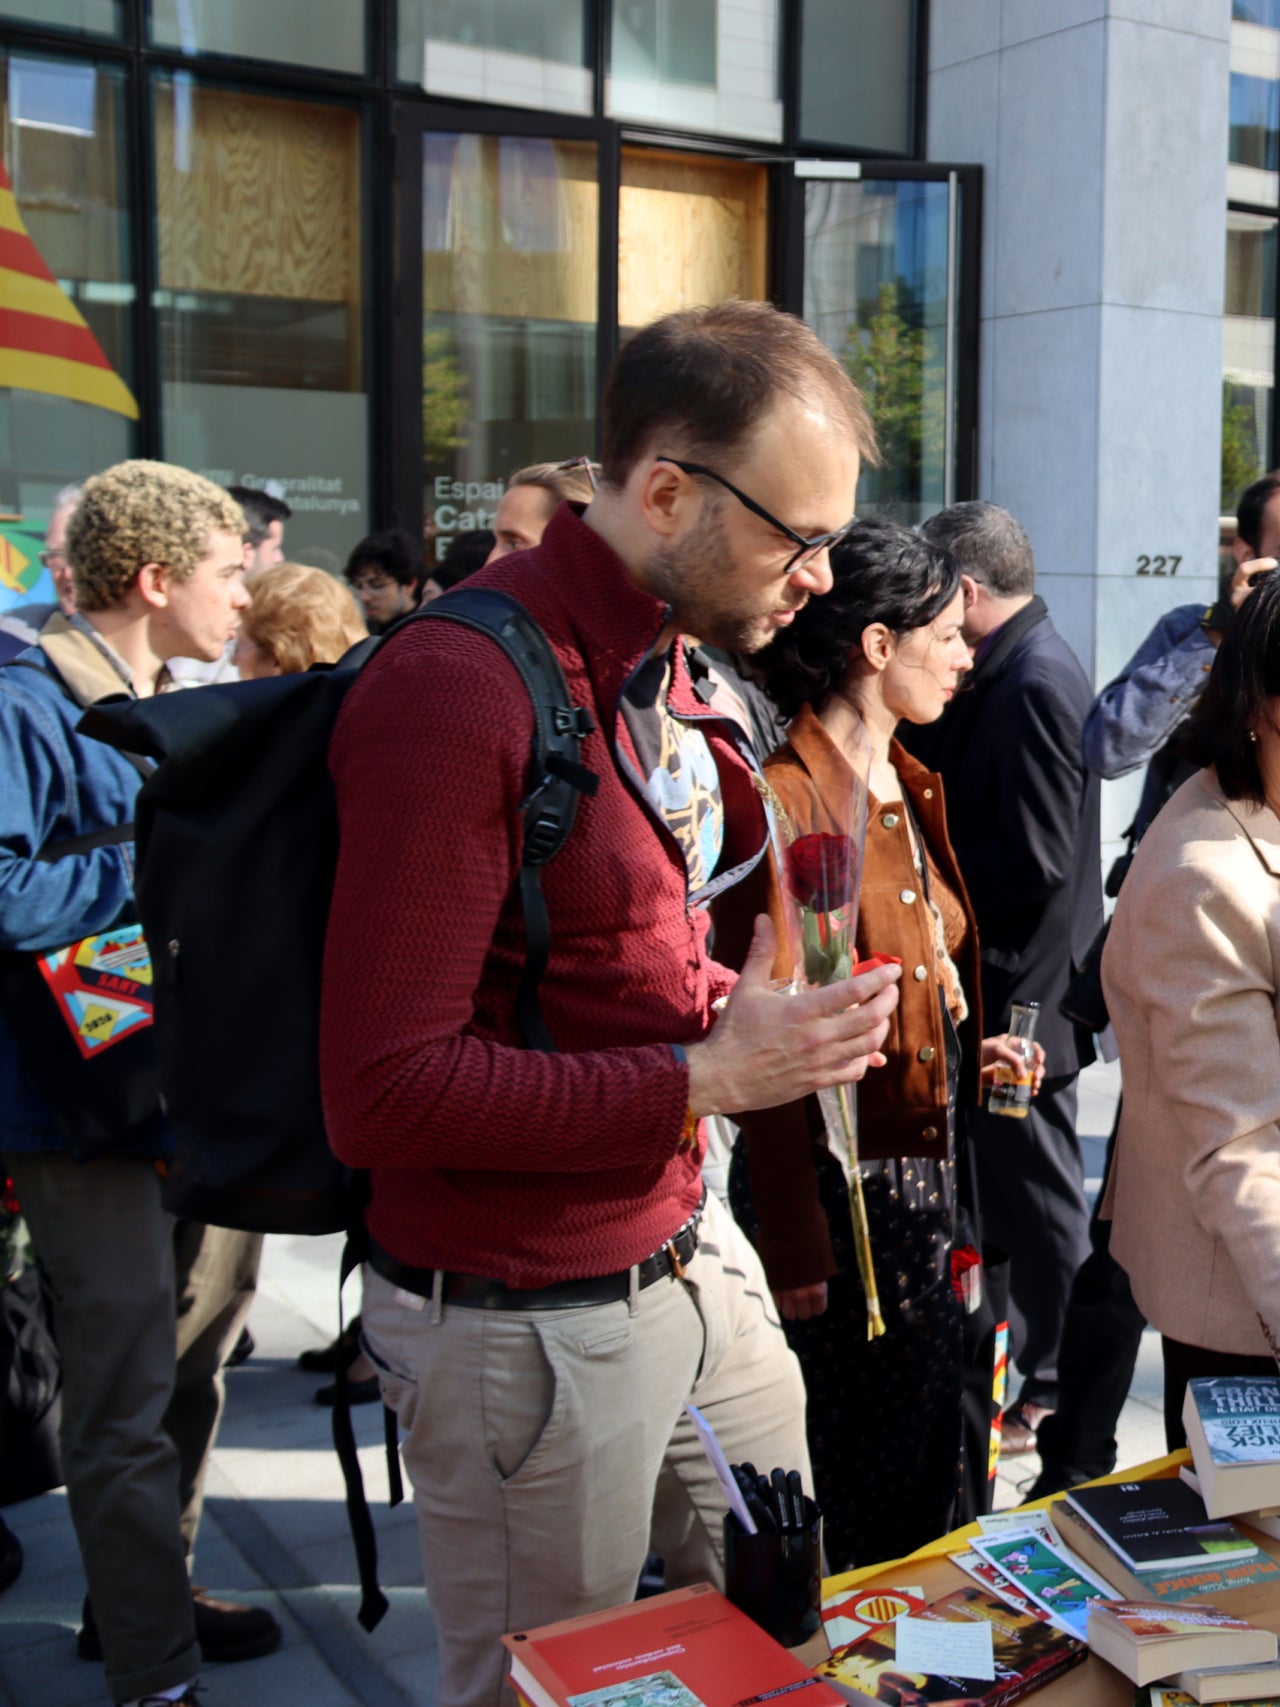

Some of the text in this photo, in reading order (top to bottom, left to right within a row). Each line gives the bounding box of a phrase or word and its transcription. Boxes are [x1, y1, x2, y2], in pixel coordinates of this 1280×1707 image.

[241, 473, 343, 493] Geeralitat
[434, 476, 504, 505] Espai
[286, 495, 360, 516] atalunya
[1136, 555, 1182, 576] 227
[96, 973, 140, 995] SANT
[1223, 1561, 1279, 1579] PLUIE
[1152, 1571, 1223, 1596] ROUGE
